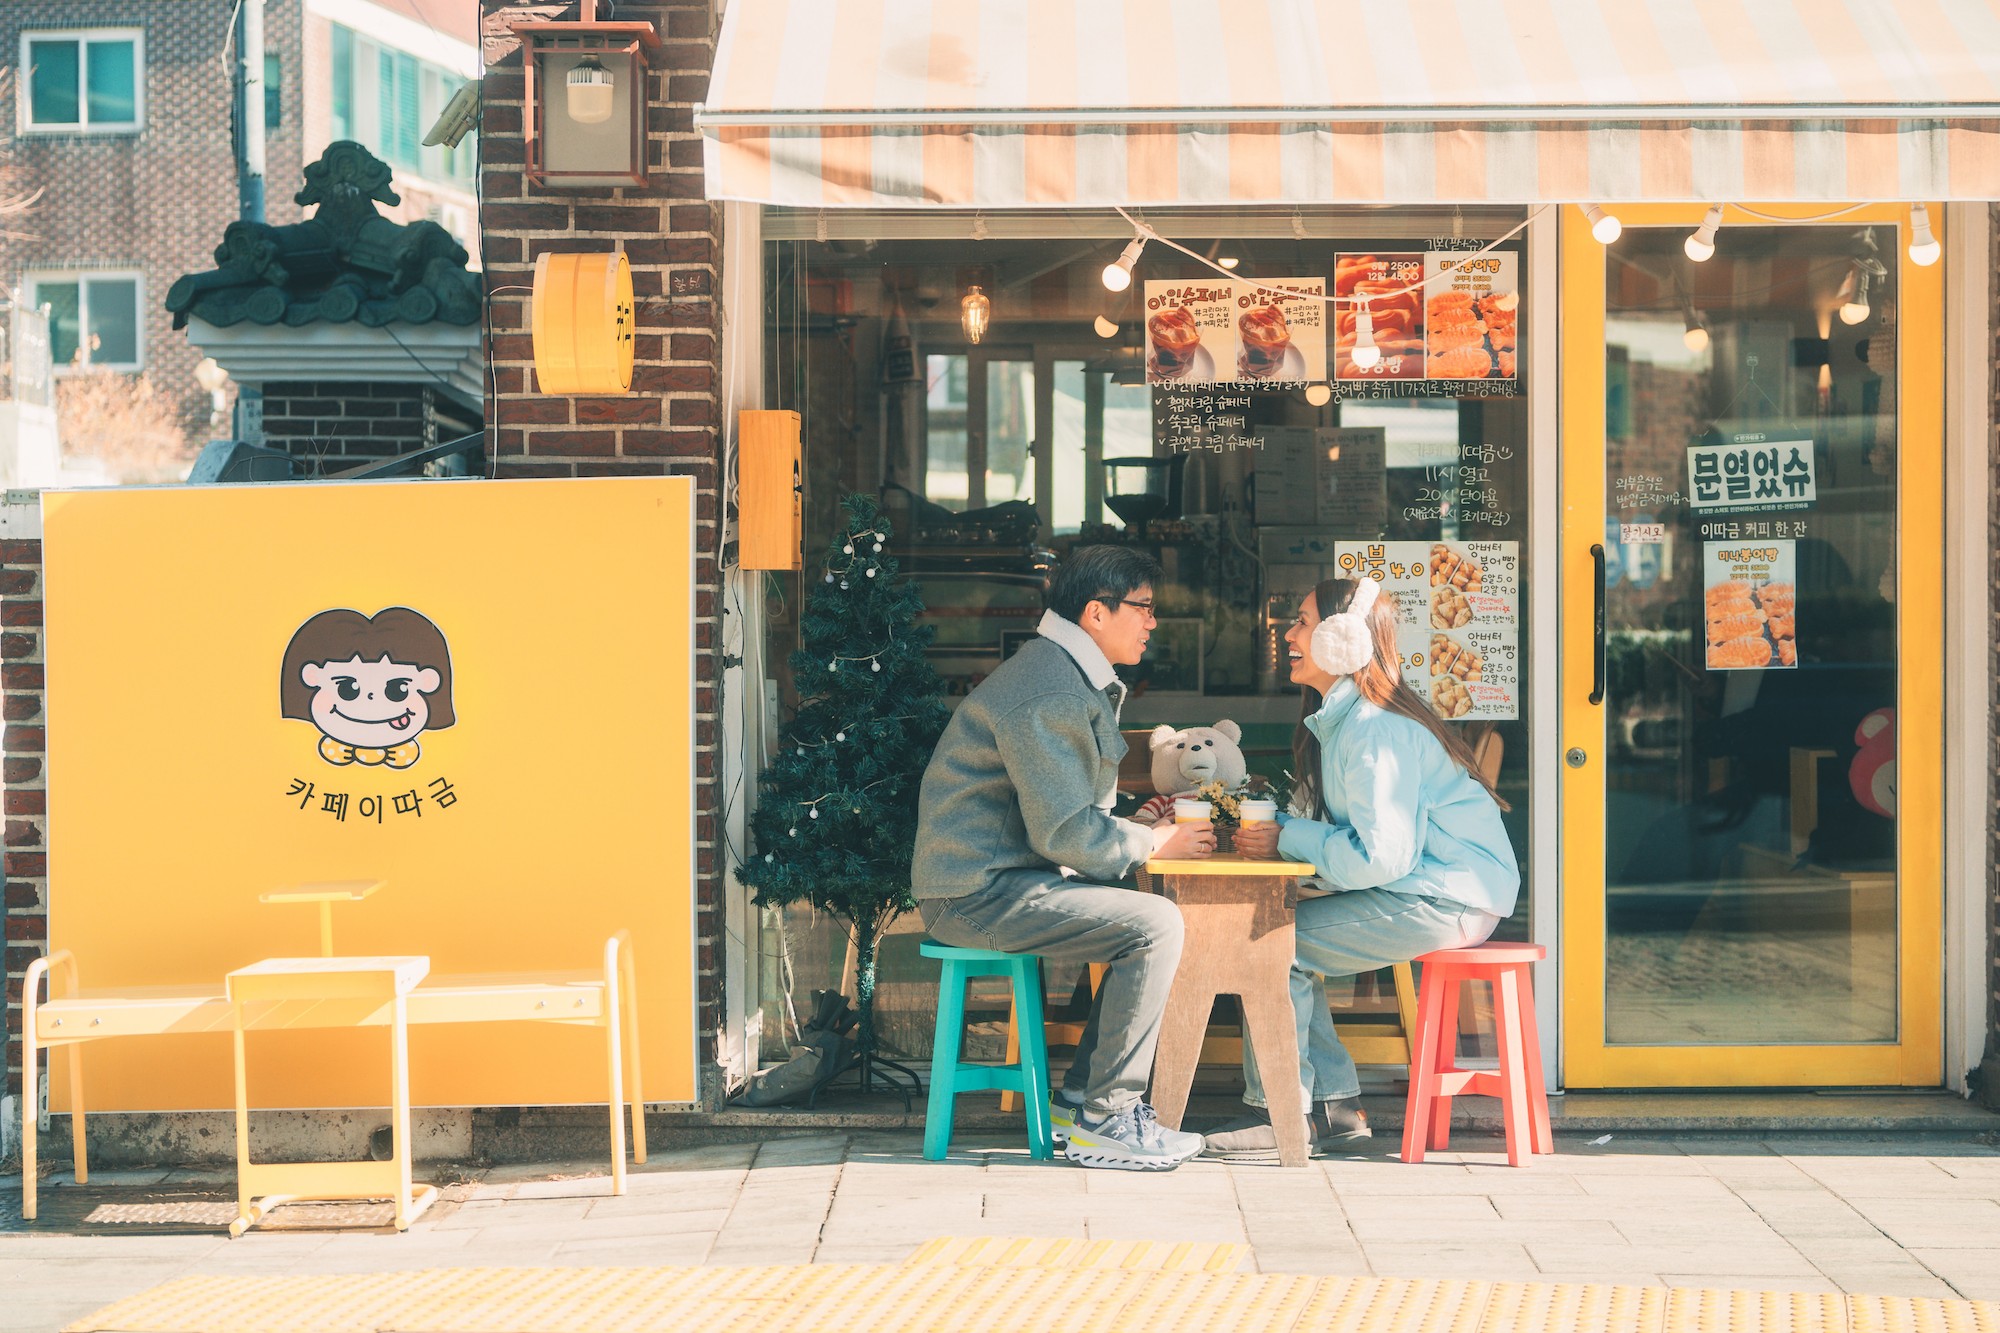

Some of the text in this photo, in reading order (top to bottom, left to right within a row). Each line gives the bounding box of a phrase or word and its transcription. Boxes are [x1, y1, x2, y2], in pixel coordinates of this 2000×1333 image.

[1391, 261, 1419, 271] 2500
[1391, 271, 1419, 281] 4500
[1147, 286, 1232, 310] 아인슈페너
[1359, 356, 1403, 374] 콩빵
[1330, 380, 1369, 404] 붕어빵
[1371, 380, 1392, 399] 종류
[1443, 380, 1465, 398] 완전
[1215, 395, 1251, 409] 슈페너
[1168, 415, 1245, 434] 쑥크림 슈페너
[1169, 433, 1265, 454] 쿠앤크 크림 슈페너
[1459, 466, 1492, 485] 열고
[1616, 474, 1664, 491] 외부음식은
[1415, 488, 1454, 505] 20시
[1461, 510, 1511, 526] 조기마감)
[1622, 525, 1662, 538] 당기시오
[1701, 521, 1807, 539] 이따금 커피 한 잔
[1468, 543, 1502, 558] 앙버터
[1718, 547, 1779, 562] 미니붕어빵
[1480, 556, 1516, 572] 붕어빵
[1468, 632, 1502, 647] 앙버터
[1480, 645, 1516, 661] 붕어빵
[286, 776, 457, 824] 카페이따금
